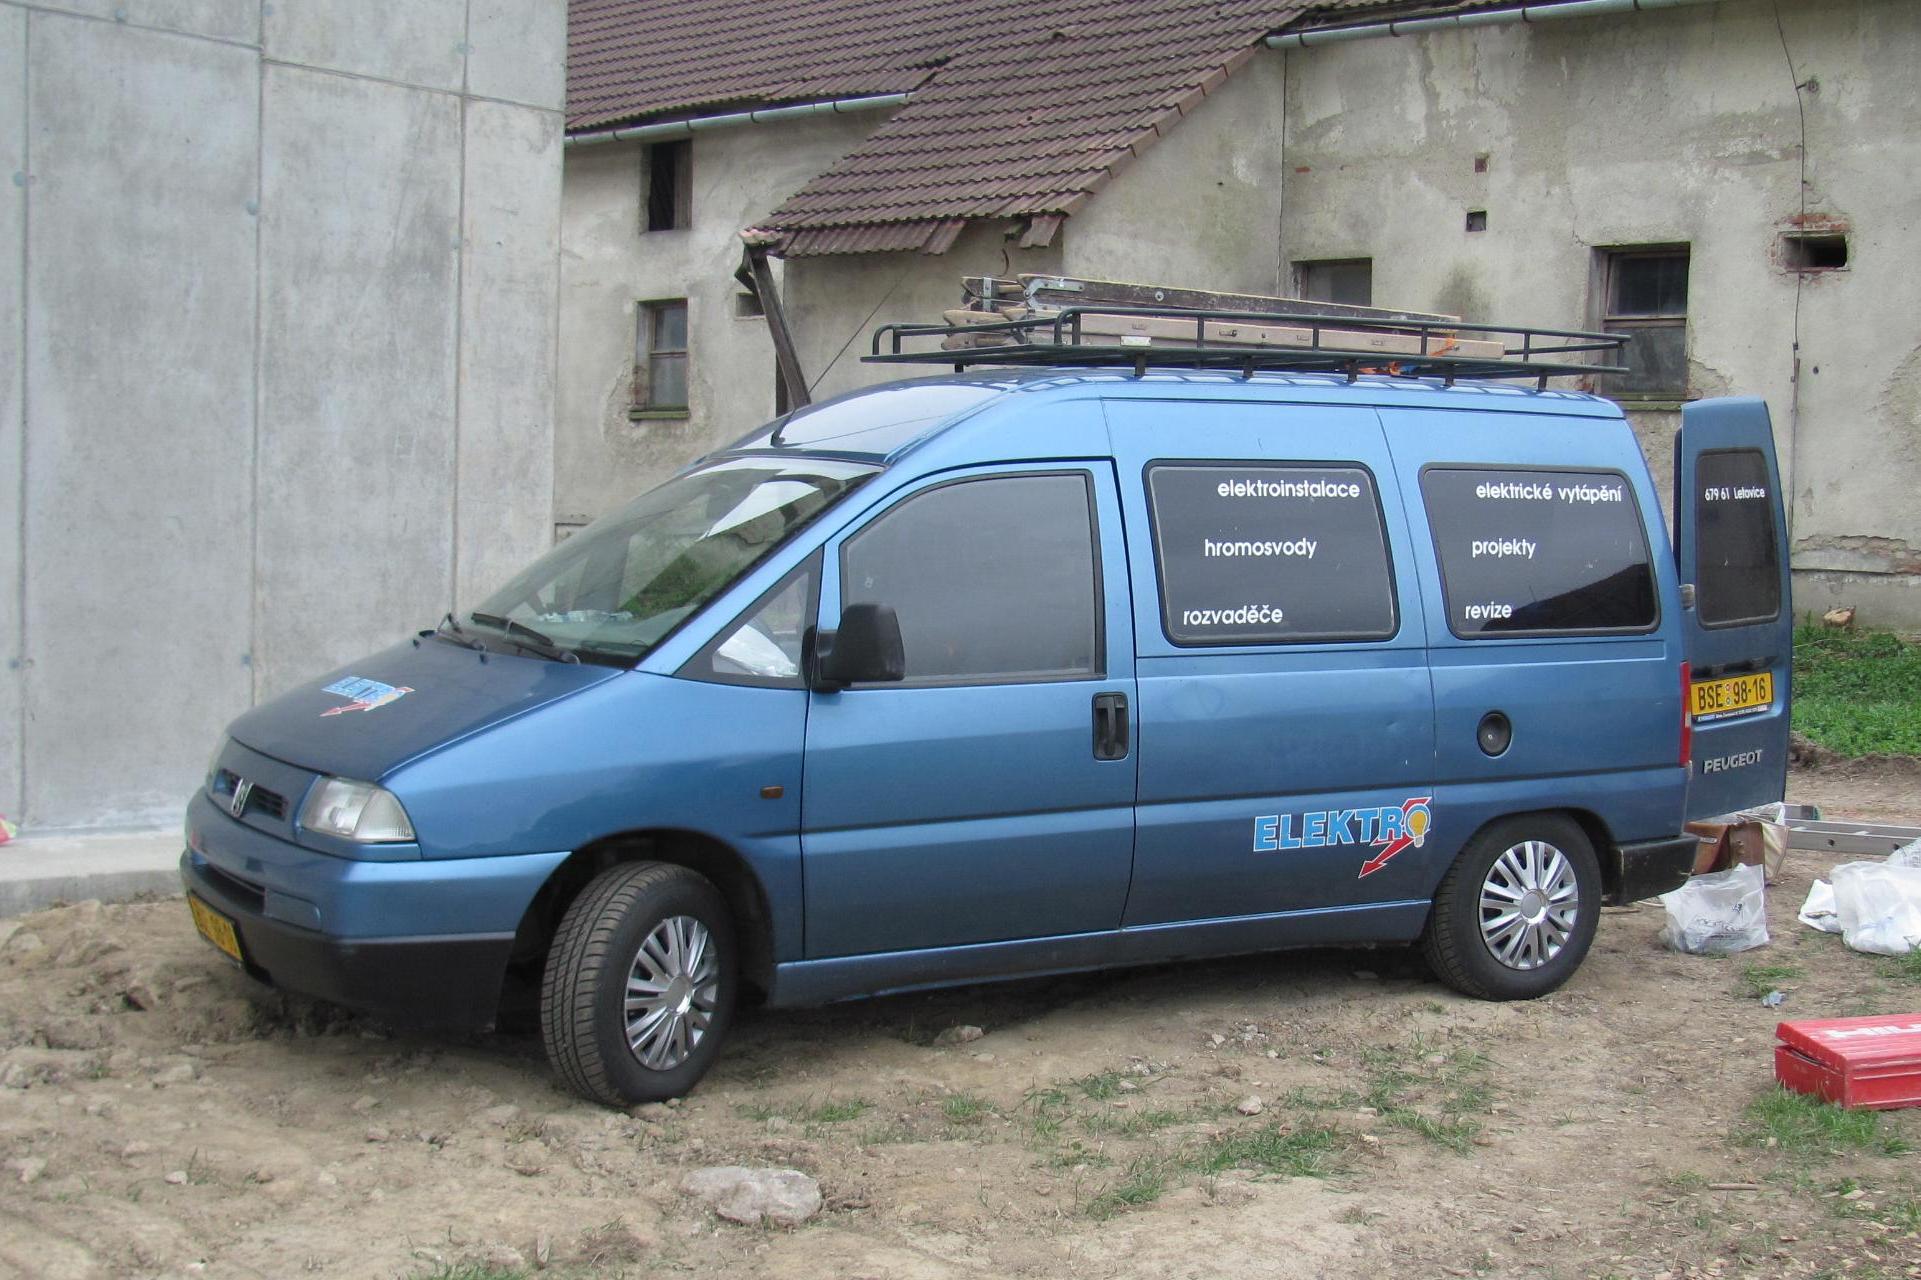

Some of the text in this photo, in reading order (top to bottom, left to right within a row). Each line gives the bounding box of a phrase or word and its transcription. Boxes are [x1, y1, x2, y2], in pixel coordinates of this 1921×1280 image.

[1217, 480, 1360, 498] elektroinstalace
[1476, 482, 1622, 504] elektrické vytápění
[1704, 488, 1719, 501] 679
[1721, 488, 1730, 500] 61
[1204, 538, 1317, 558] hromosvody
[1472, 538, 1536, 559] projekty
[1183, 604, 1283, 625] rozvaděče
[1465, 601, 1512, 619] revize
[1698, 677, 1767, 711] BSE 98-16
[1703, 749, 1763, 774] PEUGEOT
